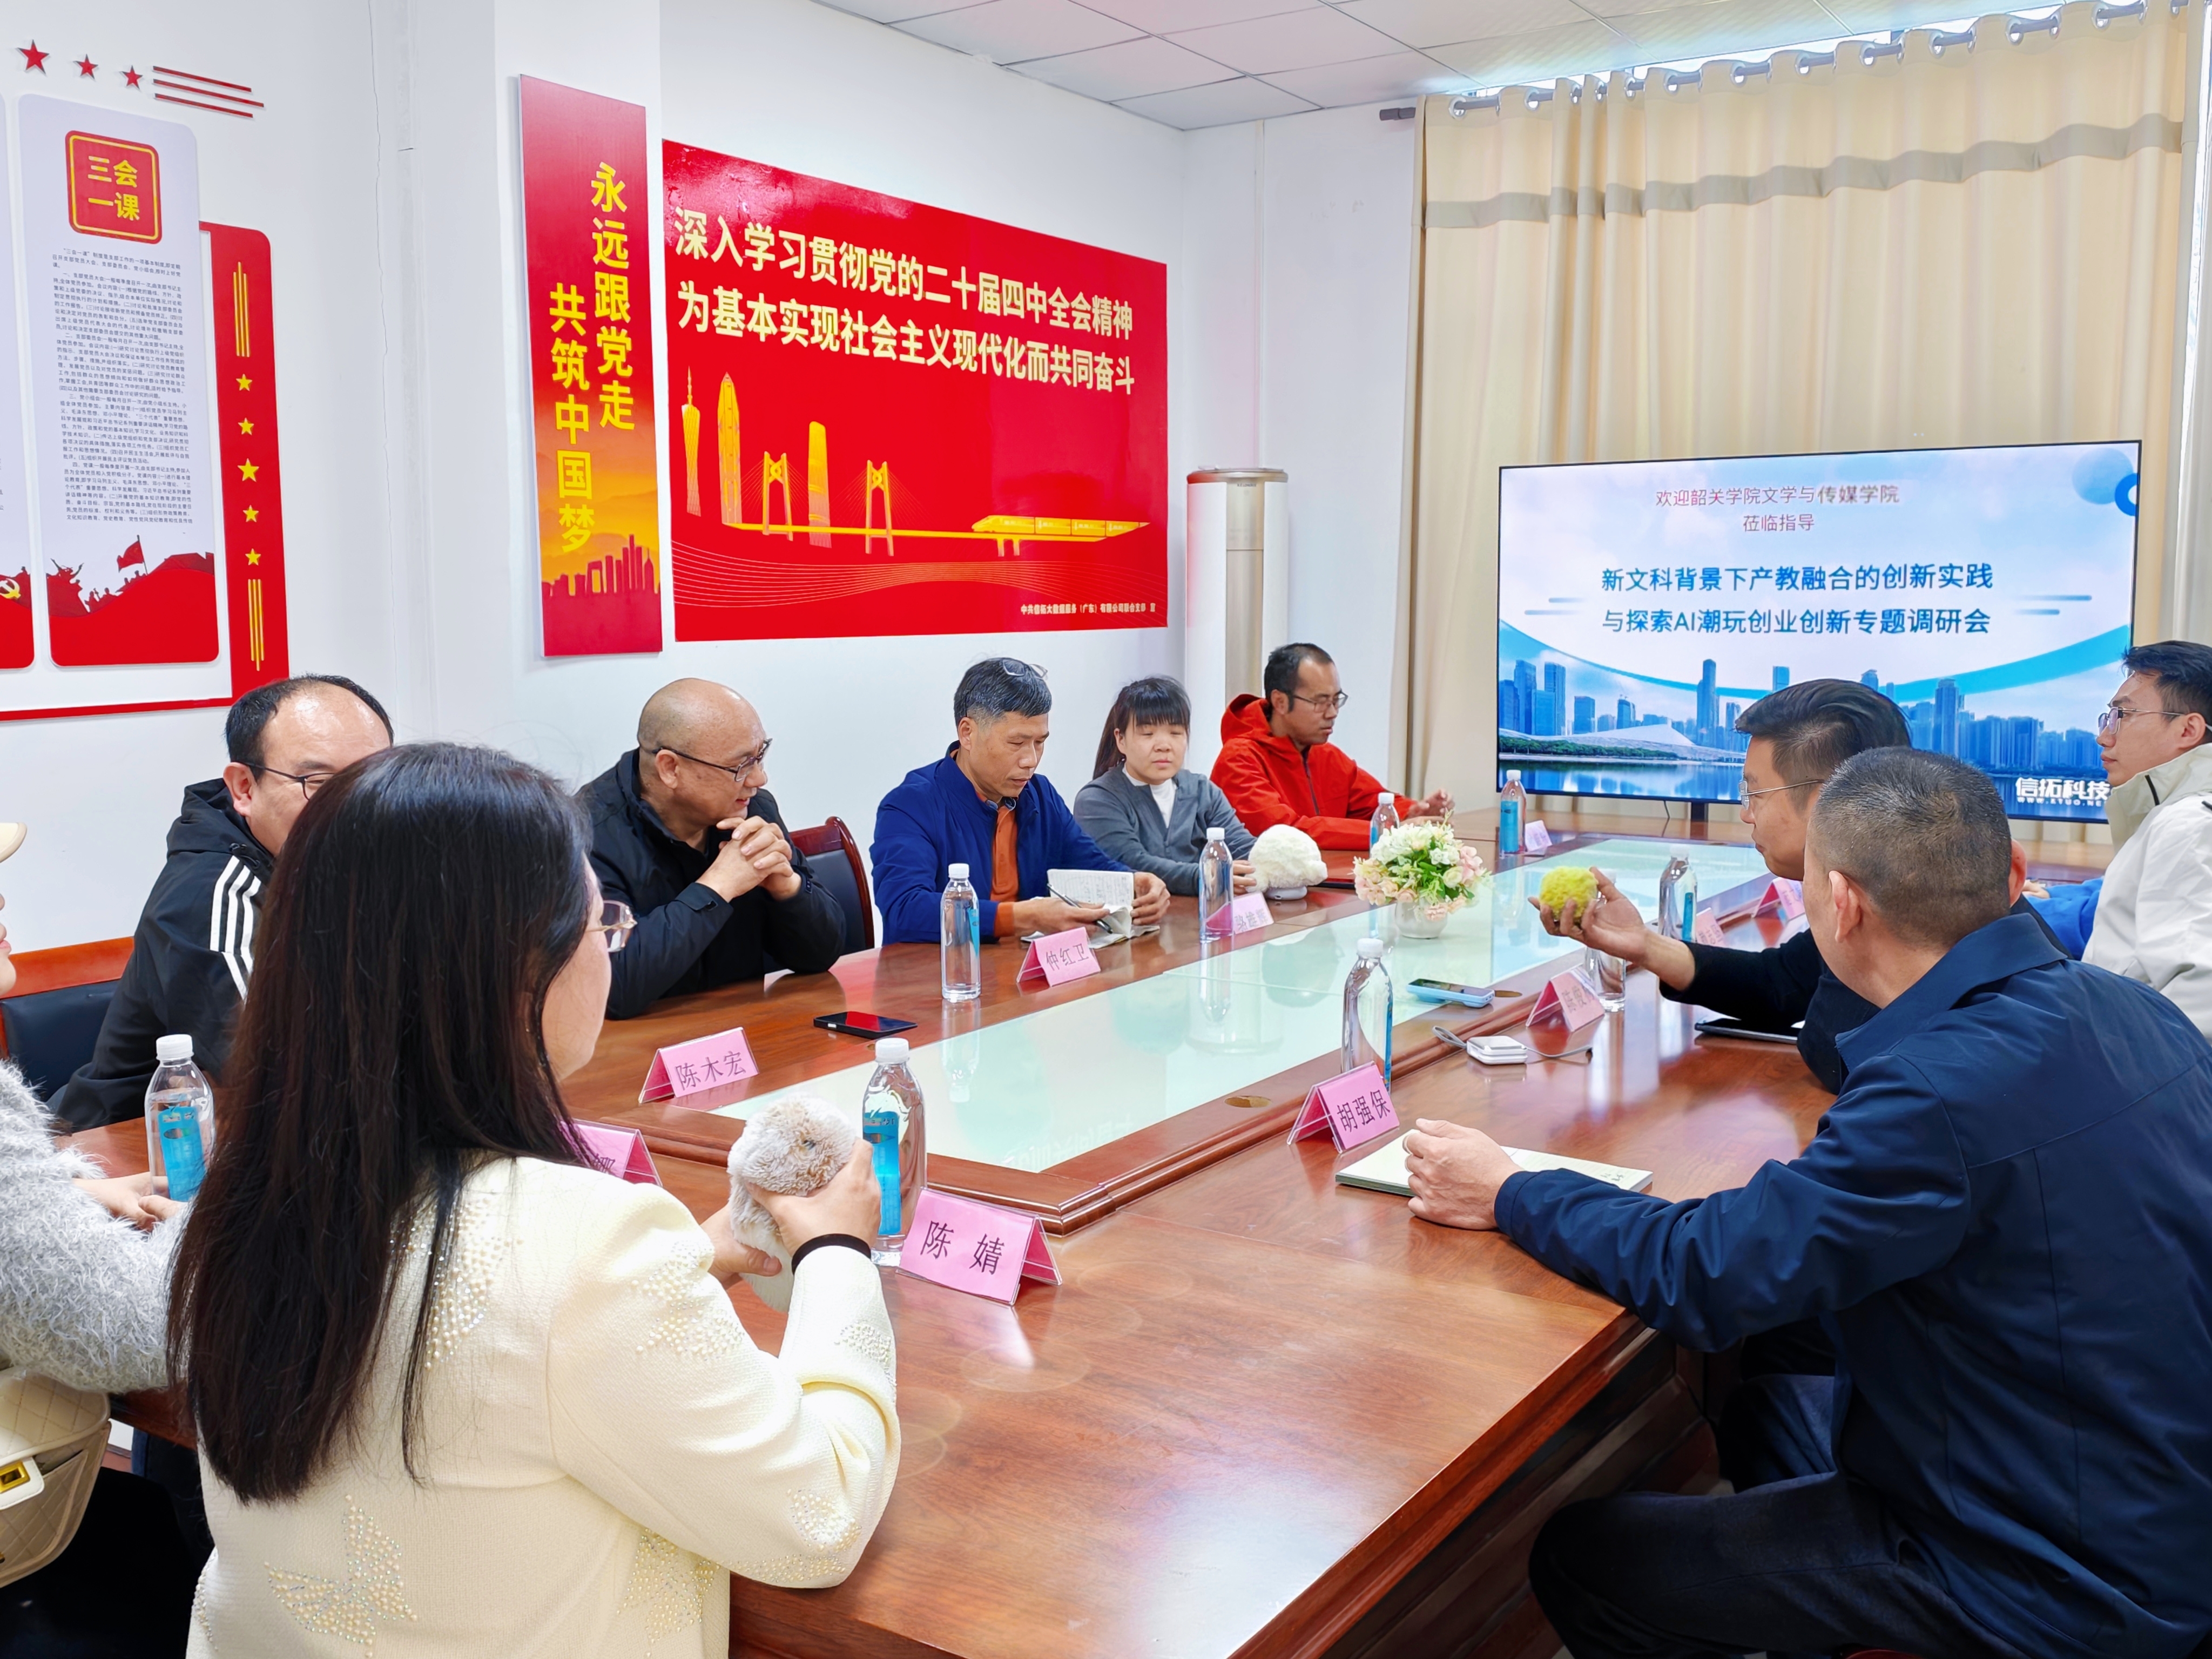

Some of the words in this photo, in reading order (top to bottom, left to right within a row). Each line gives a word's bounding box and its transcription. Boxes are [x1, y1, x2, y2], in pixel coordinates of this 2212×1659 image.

[88, 156, 137, 188] 三会
[88, 192, 140, 221] 一课
[673, 206, 1132, 340] 深入学习贯彻党的二十届四中全会精神
[591, 161, 635, 431] 永远跟党走
[677, 280, 1135, 395] 为基本实现社会主义现代化而共同奋斗
[549, 282, 595, 553] 共筑中国梦
[1656, 484, 1900, 507] 欢迎韶关学院文学与传媒学院
[1743, 514, 1815, 532] 莅临指导
[1602, 563, 1993, 592] 新文科背景下产教融合的创新实践
[1602, 608, 1991, 635] 与探索AI潮玩创业创新专题调研会
[2015, 777, 2110, 800] 信拓科技
[1046, 943, 1089, 971] 仲红卫
[675, 1050, 746, 1091] 陈木宏
[1337, 1088, 1391, 1133] 胡强保
